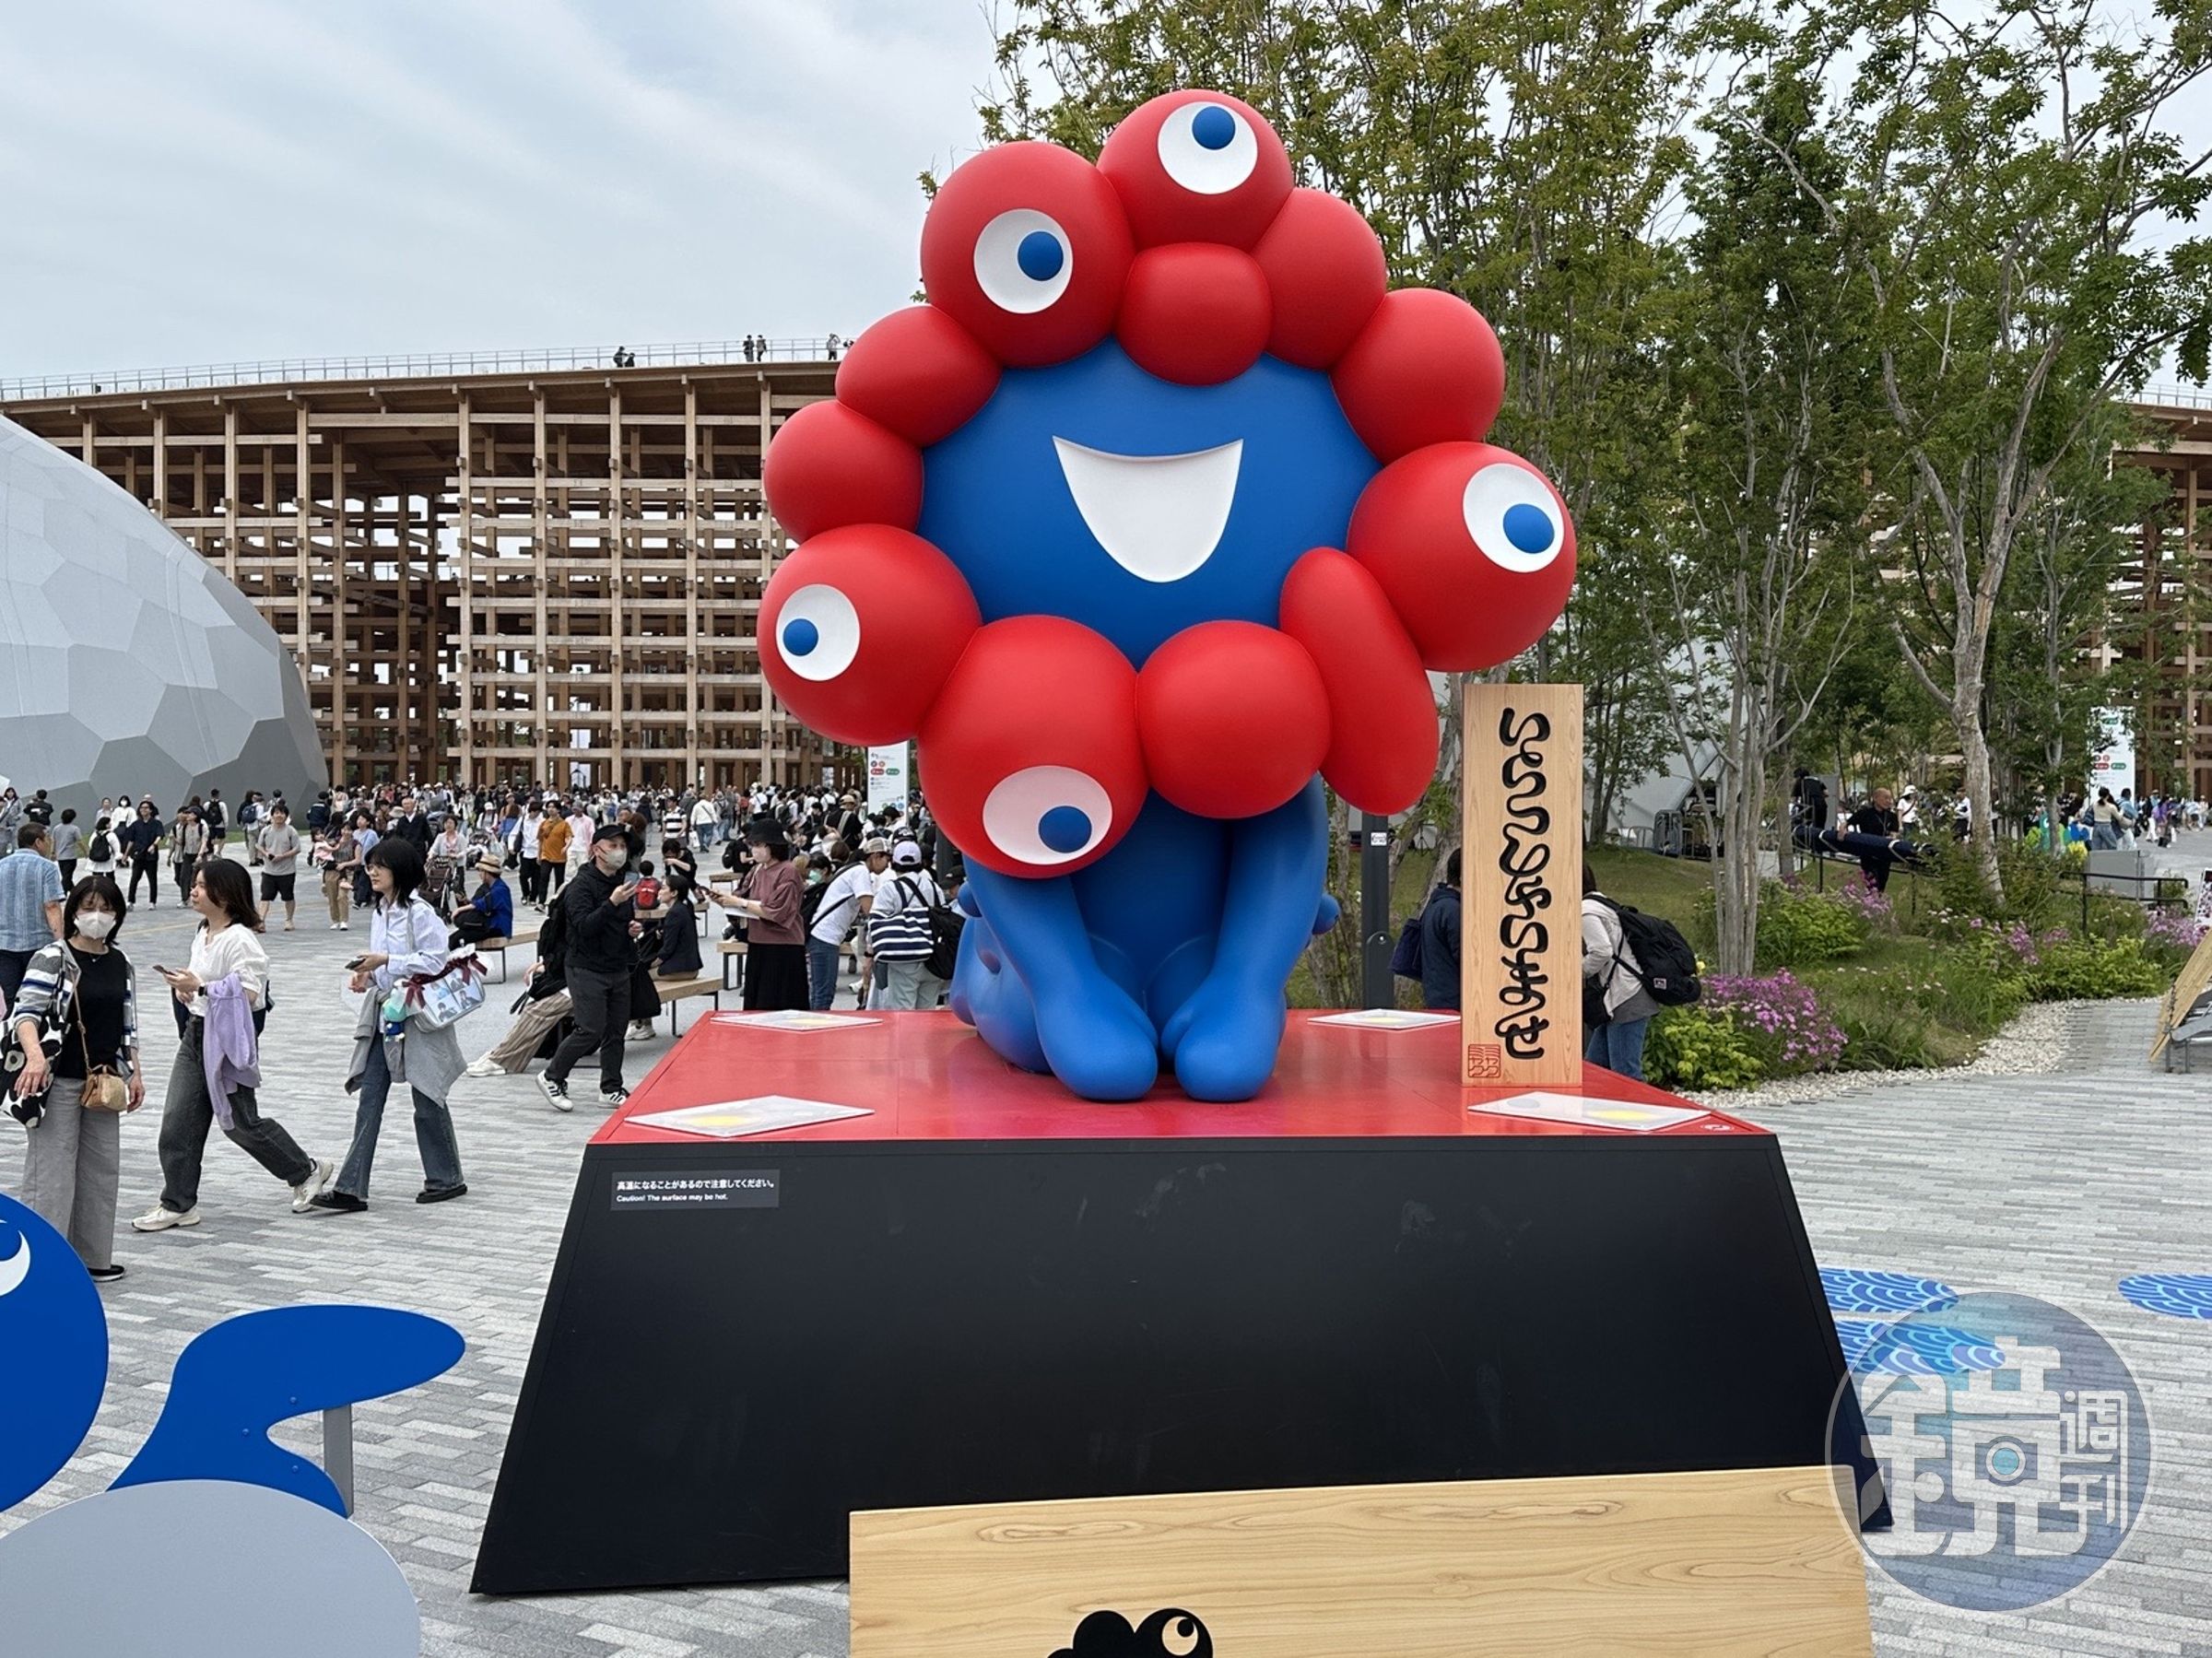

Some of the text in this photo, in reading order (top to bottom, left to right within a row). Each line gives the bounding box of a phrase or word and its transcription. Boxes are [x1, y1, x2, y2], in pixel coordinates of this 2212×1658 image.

[617, 1179, 775, 1191] 高温になることがあるので注意してください。
[616, 1194, 646, 1203] Caution!
[662, 1194, 688, 1202] surface
